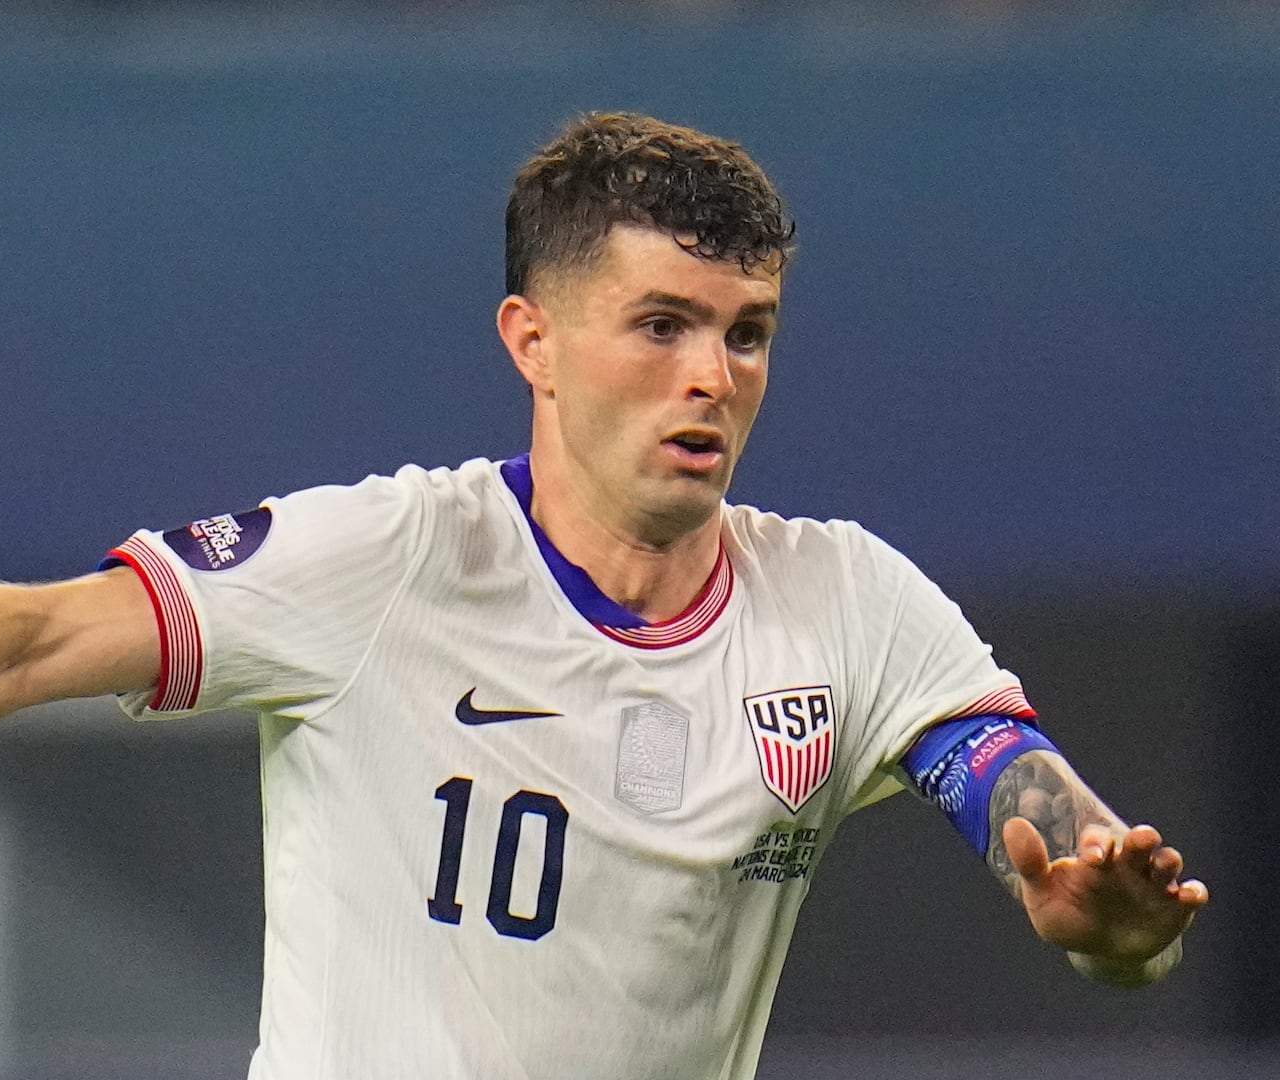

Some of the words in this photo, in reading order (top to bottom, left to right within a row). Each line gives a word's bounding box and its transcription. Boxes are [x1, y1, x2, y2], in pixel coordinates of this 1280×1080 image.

[198, 537, 220, 569] FINALS
[201, 521, 236, 564] LEAGUE
[753, 694, 829, 741] USA
[971, 731, 1013, 768] QATAR
[427, 776, 570, 941] 10
